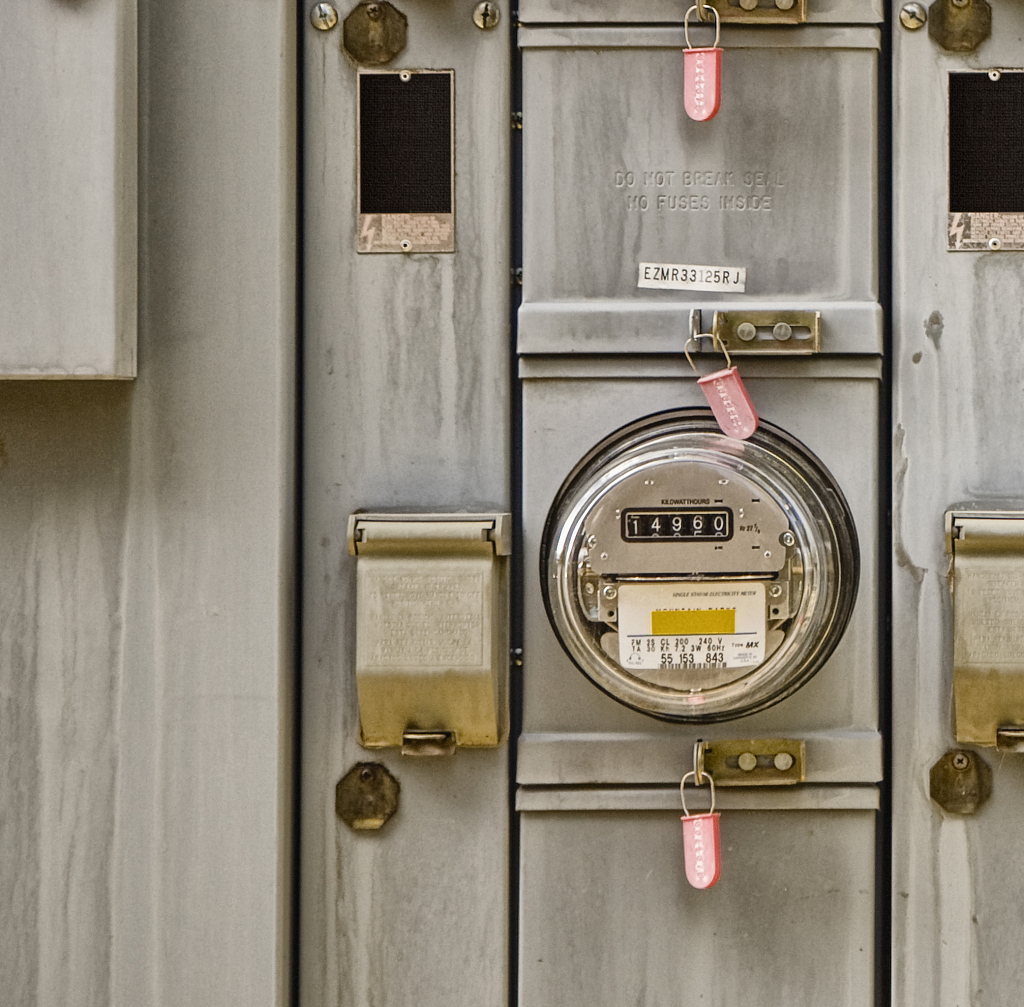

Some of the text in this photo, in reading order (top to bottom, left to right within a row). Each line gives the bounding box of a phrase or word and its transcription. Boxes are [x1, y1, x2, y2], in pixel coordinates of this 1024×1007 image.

[615, 171, 635, 187] DO
[657, 196, 710, 211] FUSES
[644, 267, 740, 284] EZMR33125RJ
[633, 515, 724, 534] 14960
[661, 654, 673, 664] 55
[680, 654, 694, 664] 153
[706, 654, 724, 664] 843
